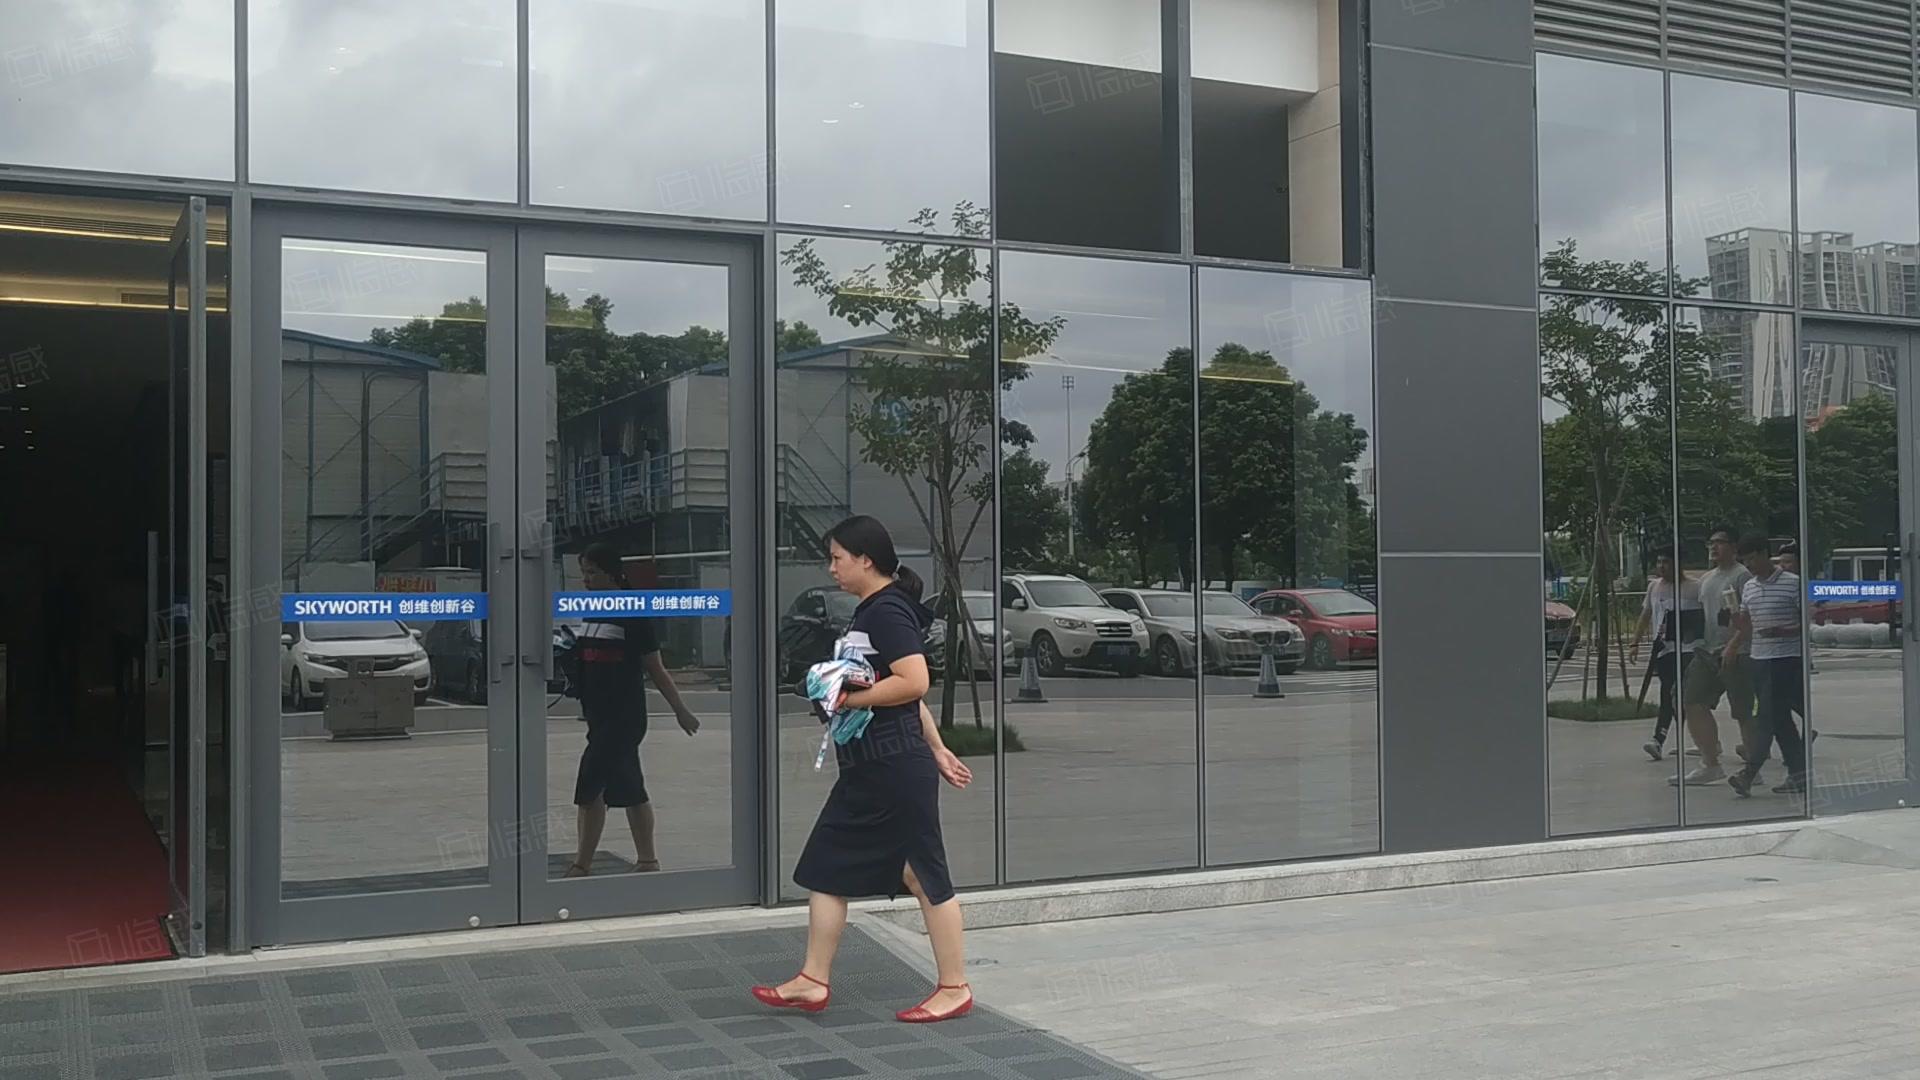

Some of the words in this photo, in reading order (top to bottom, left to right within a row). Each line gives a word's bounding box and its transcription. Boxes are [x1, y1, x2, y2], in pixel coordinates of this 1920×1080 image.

[1813, 585, 1859, 596] SKYWORTH
[294, 600, 392, 615] SKYWORTH
[399, 599, 476, 614] 创维创新谷
[558, 596, 645, 611] SKYWORTH
[651, 595, 720, 610] 创维创新谷
